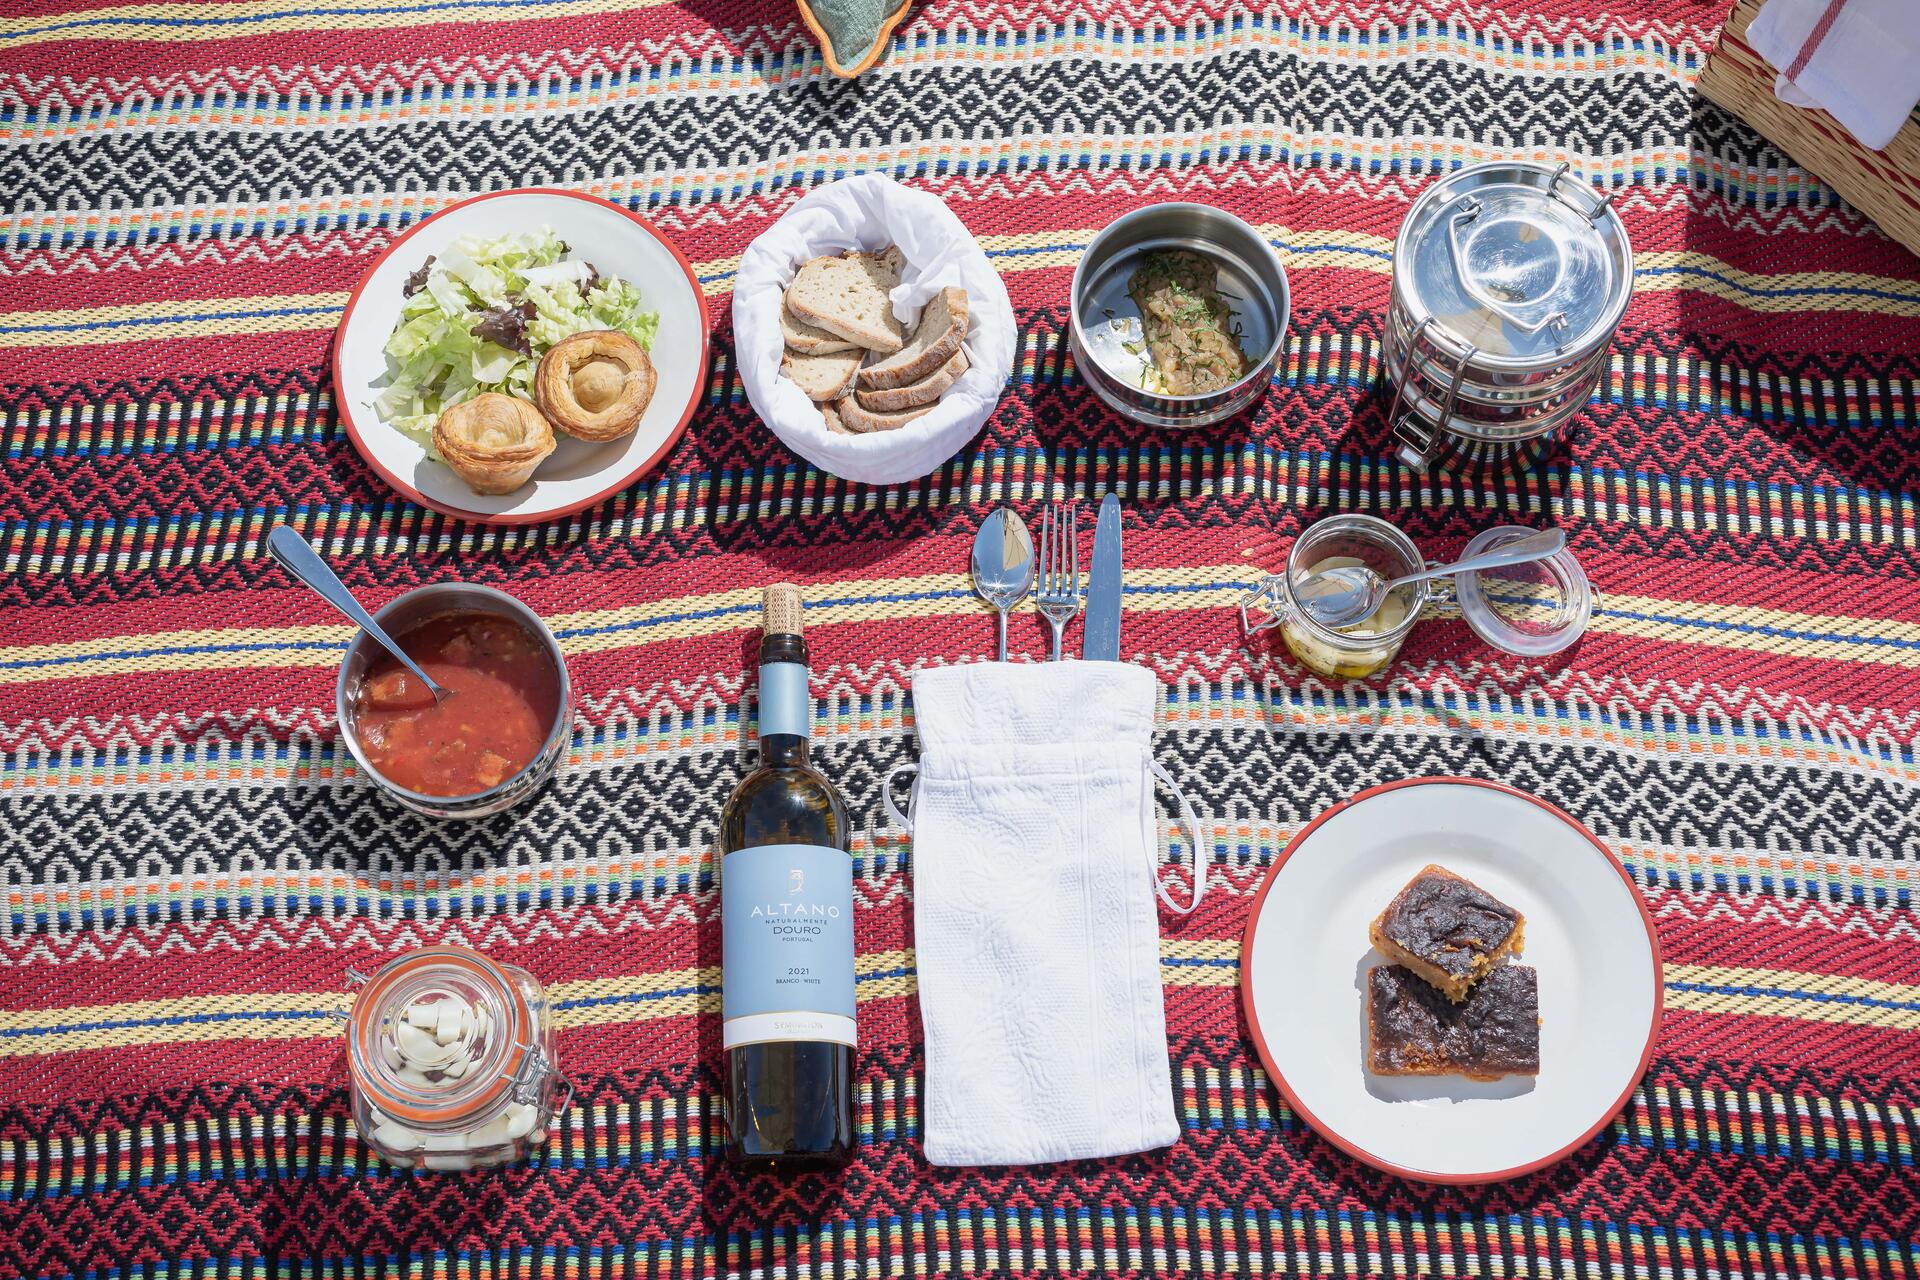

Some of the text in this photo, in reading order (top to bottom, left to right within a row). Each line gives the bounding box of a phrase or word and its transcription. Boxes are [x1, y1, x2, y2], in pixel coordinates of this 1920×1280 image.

[750, 903, 840, 918] ALTANO
[773, 926, 822, 935] DOURO
[788, 967, 809, 975] 2021
